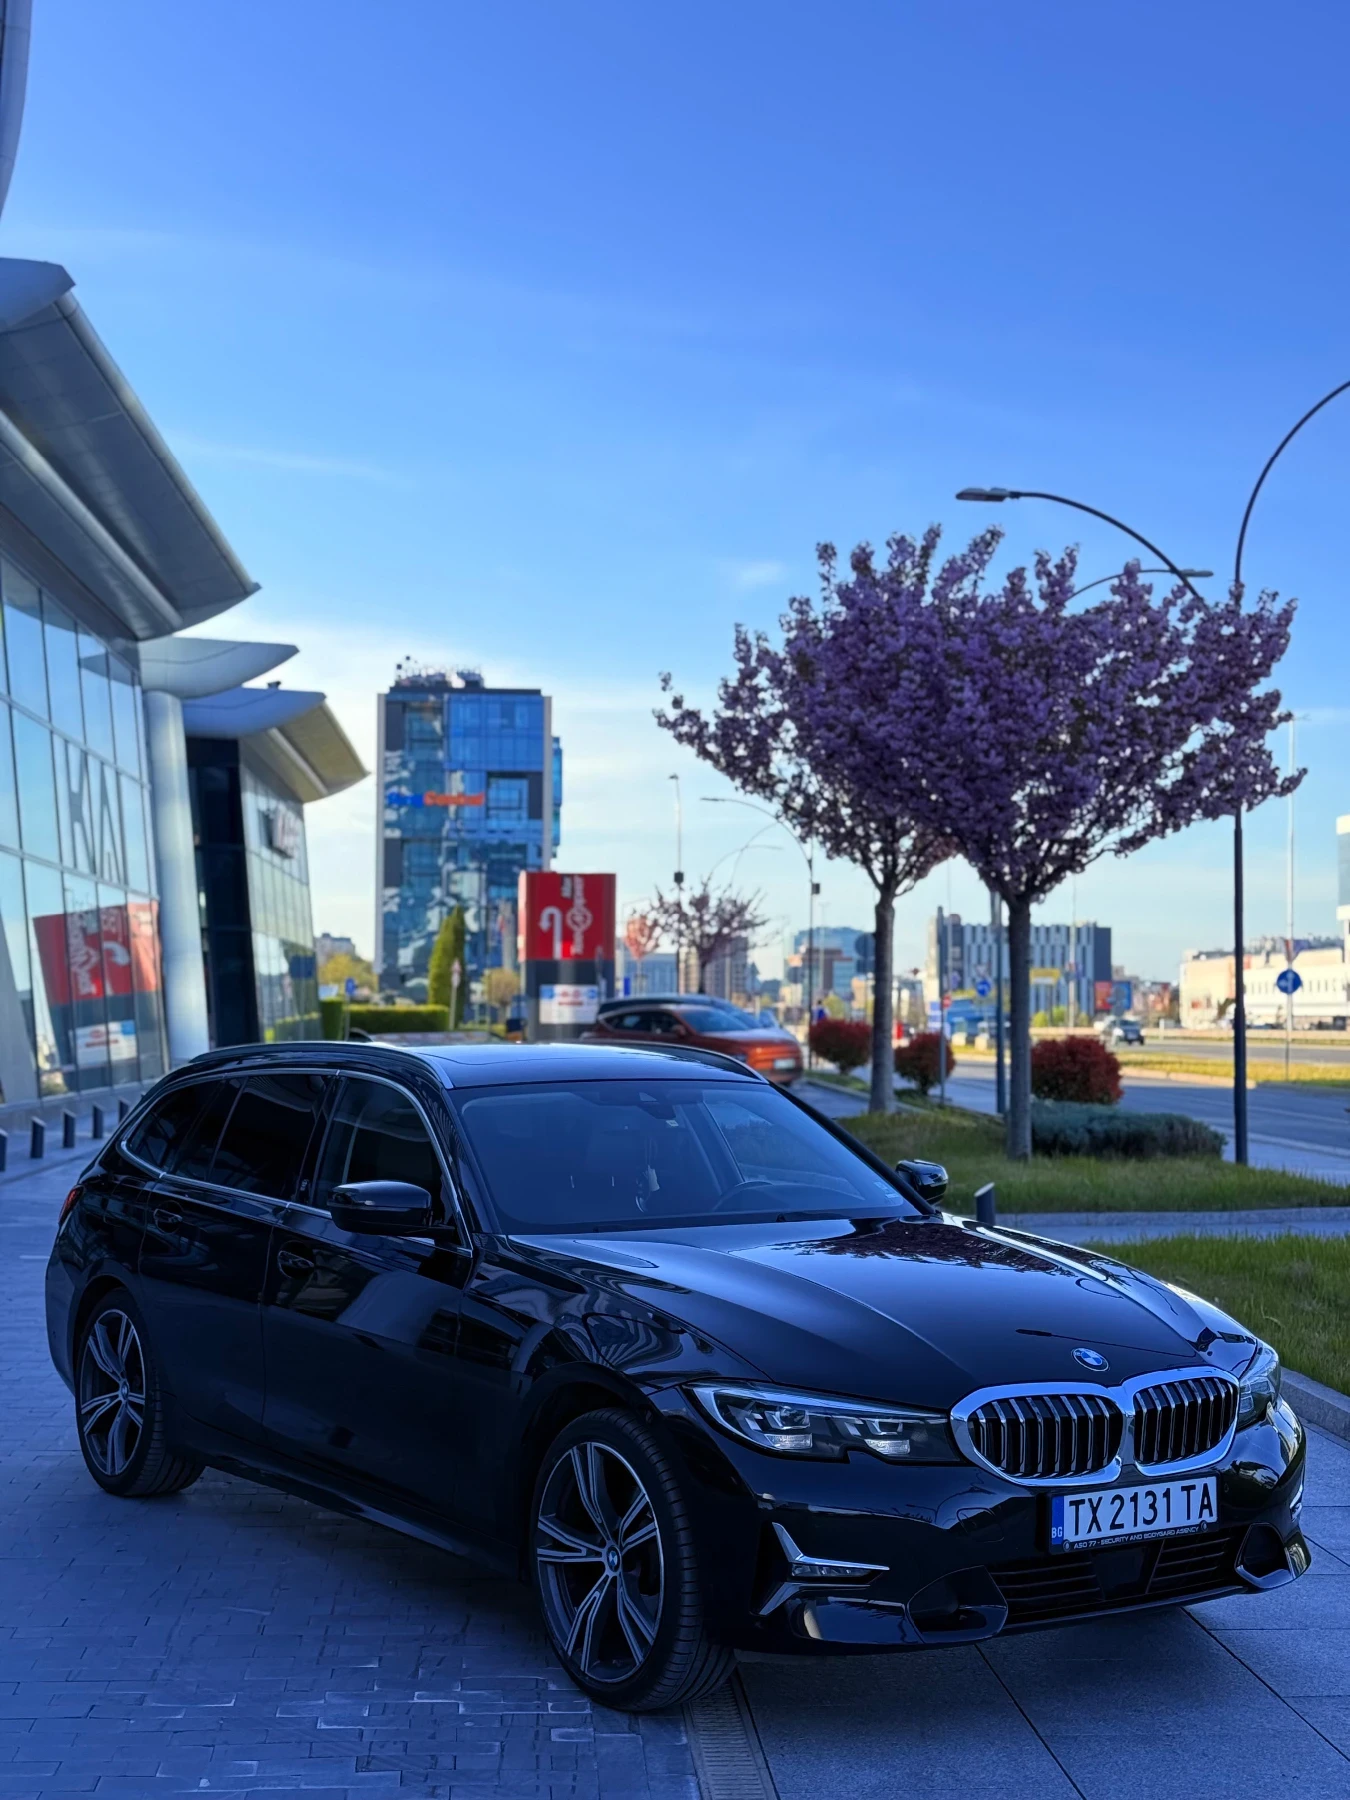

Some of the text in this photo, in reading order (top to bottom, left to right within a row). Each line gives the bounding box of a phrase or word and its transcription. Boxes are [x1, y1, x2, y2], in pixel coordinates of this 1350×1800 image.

[1069, 1482, 1214, 1536] TX 2131 TA
[1051, 1526, 1063, 1539] BG
